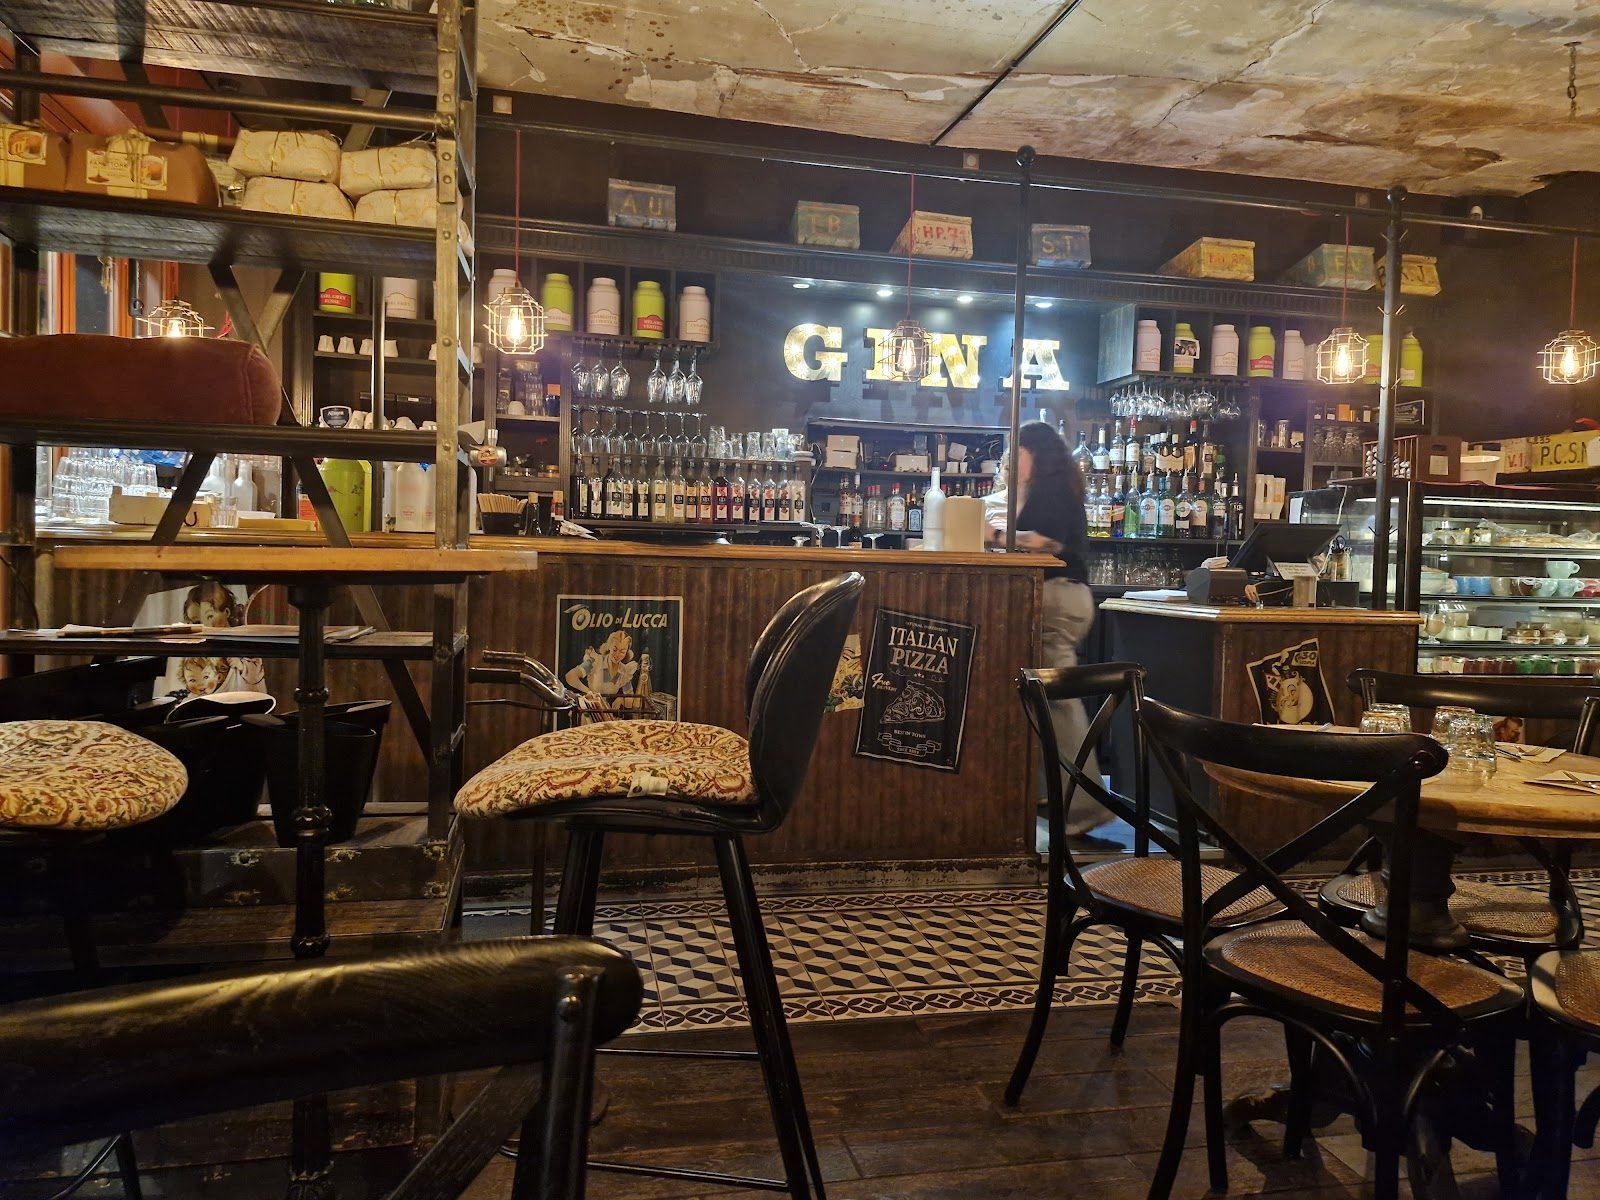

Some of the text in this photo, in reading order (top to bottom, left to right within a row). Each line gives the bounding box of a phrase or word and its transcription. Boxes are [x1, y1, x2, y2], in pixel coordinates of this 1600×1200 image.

[783, 323, 1070, 391] GINA
[571, 607, 614, 631] OLIO
[621, 607, 668, 629] LUCCA
[888, 626, 959, 657] ITALIAN
[890, 647, 949, 675] PIZZA
